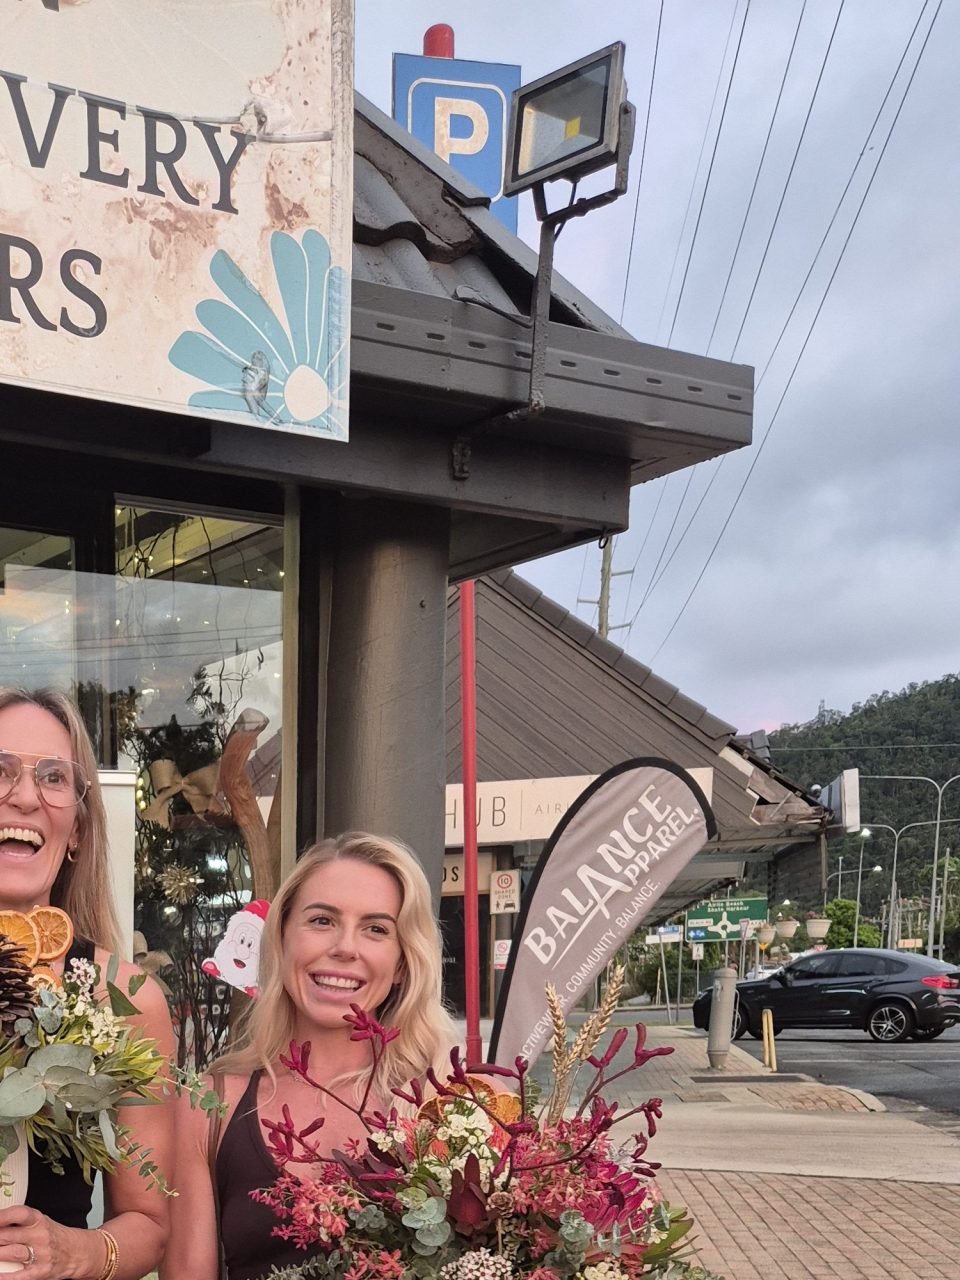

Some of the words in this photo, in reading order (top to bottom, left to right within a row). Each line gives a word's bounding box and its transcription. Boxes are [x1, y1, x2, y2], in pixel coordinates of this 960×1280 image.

[434, 96, 489, 165] P
[524, 784, 672, 966] BALANCE
[615, 879, 661, 929] BALANCE.
